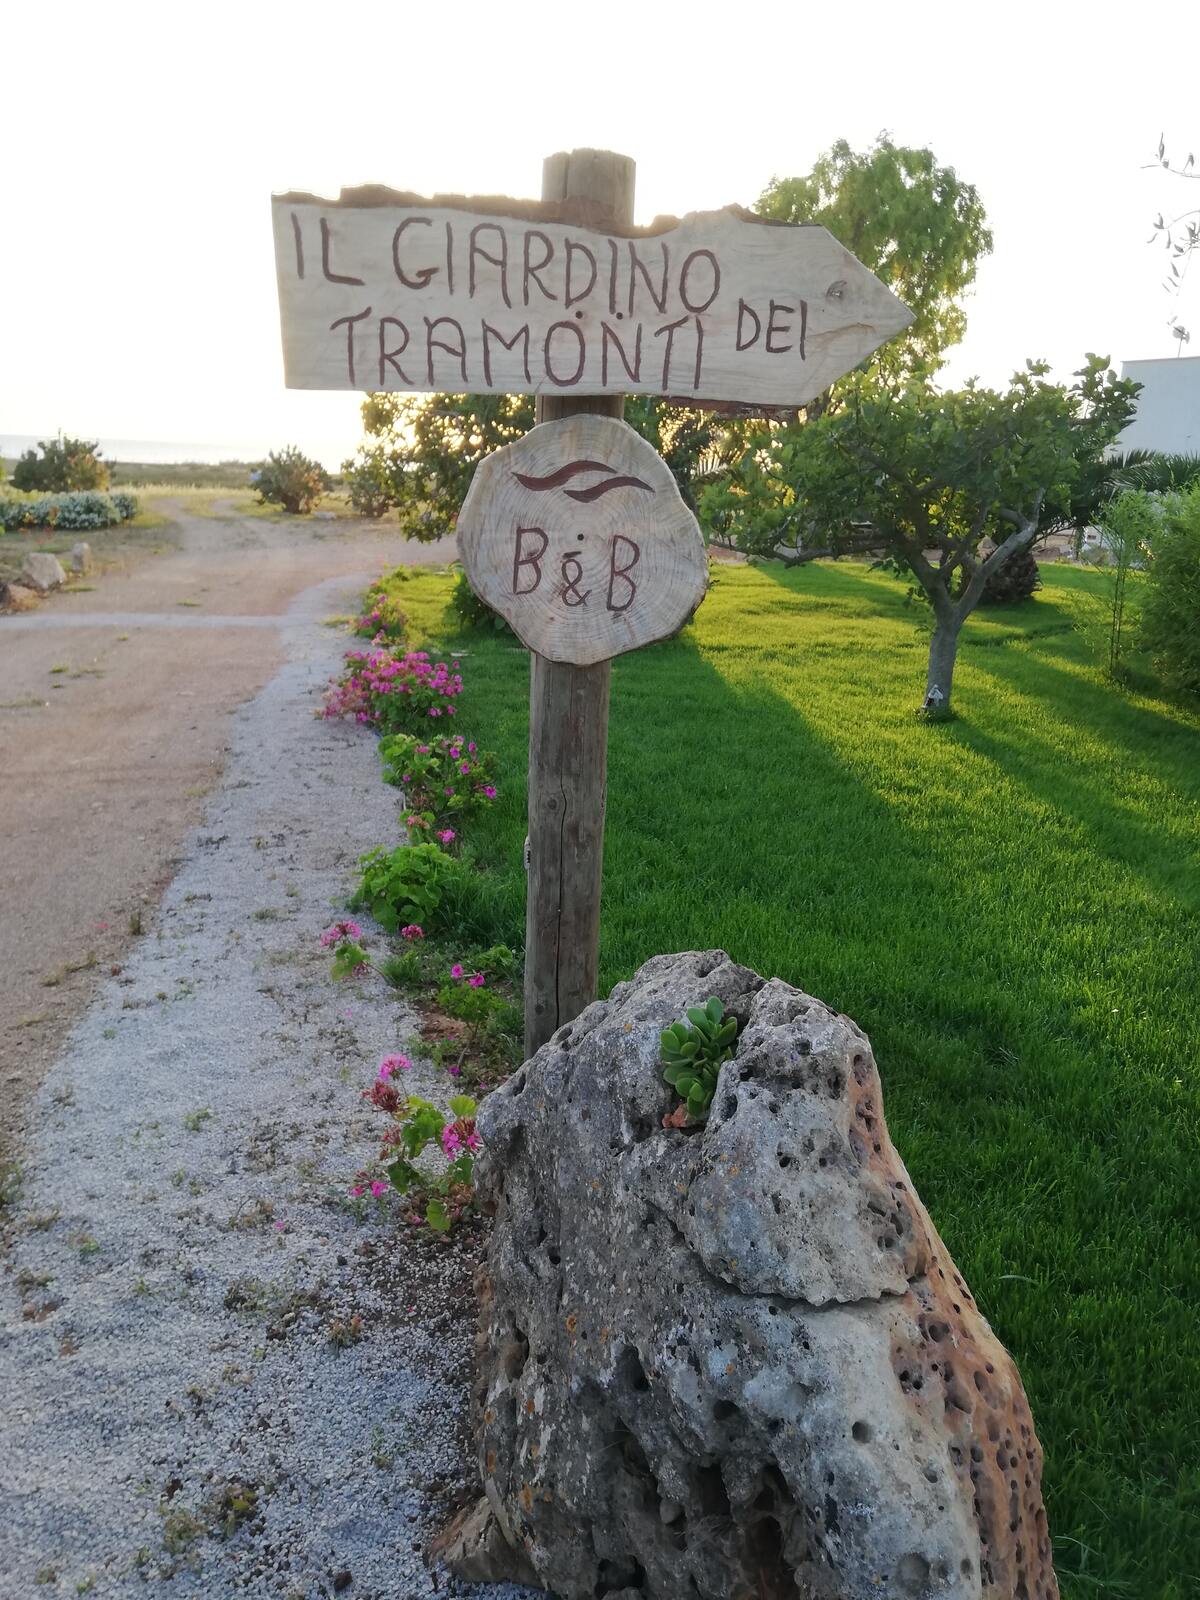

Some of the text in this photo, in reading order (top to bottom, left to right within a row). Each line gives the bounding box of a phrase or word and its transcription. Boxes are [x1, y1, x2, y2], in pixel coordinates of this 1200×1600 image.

[291, 212, 807, 361] IL GIARDINO DEI
[329, 306, 704, 391] TRAMONTI
